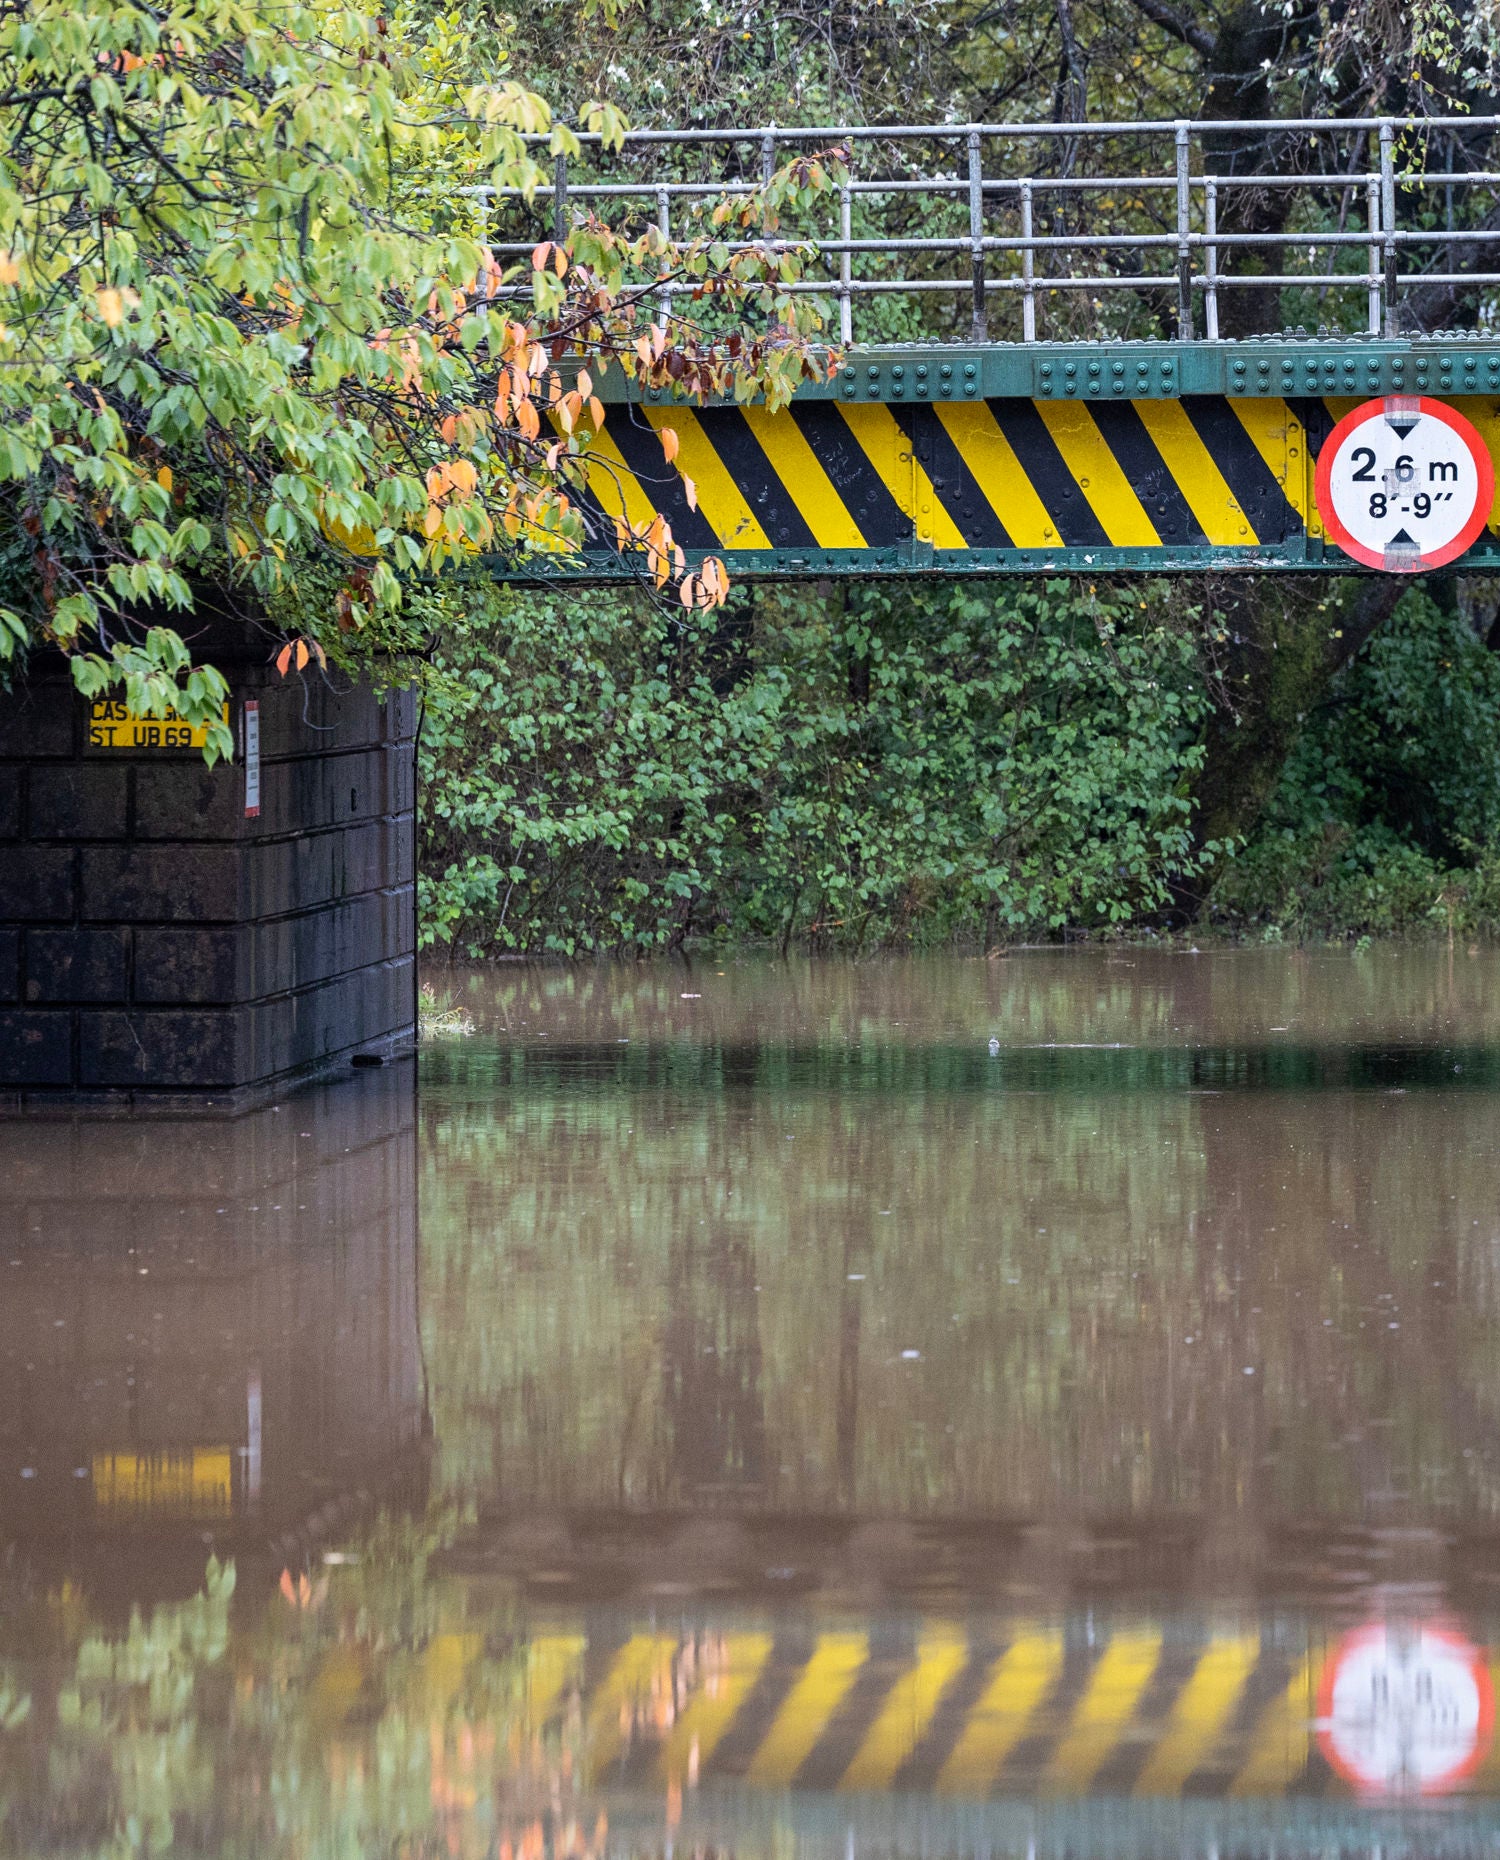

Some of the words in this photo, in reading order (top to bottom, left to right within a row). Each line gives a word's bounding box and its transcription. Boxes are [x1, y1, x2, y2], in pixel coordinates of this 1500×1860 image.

[1351, 447, 1414, 482] 2.6
[1429, 461, 1458, 482] m
[90, 727, 117, 747] ST
